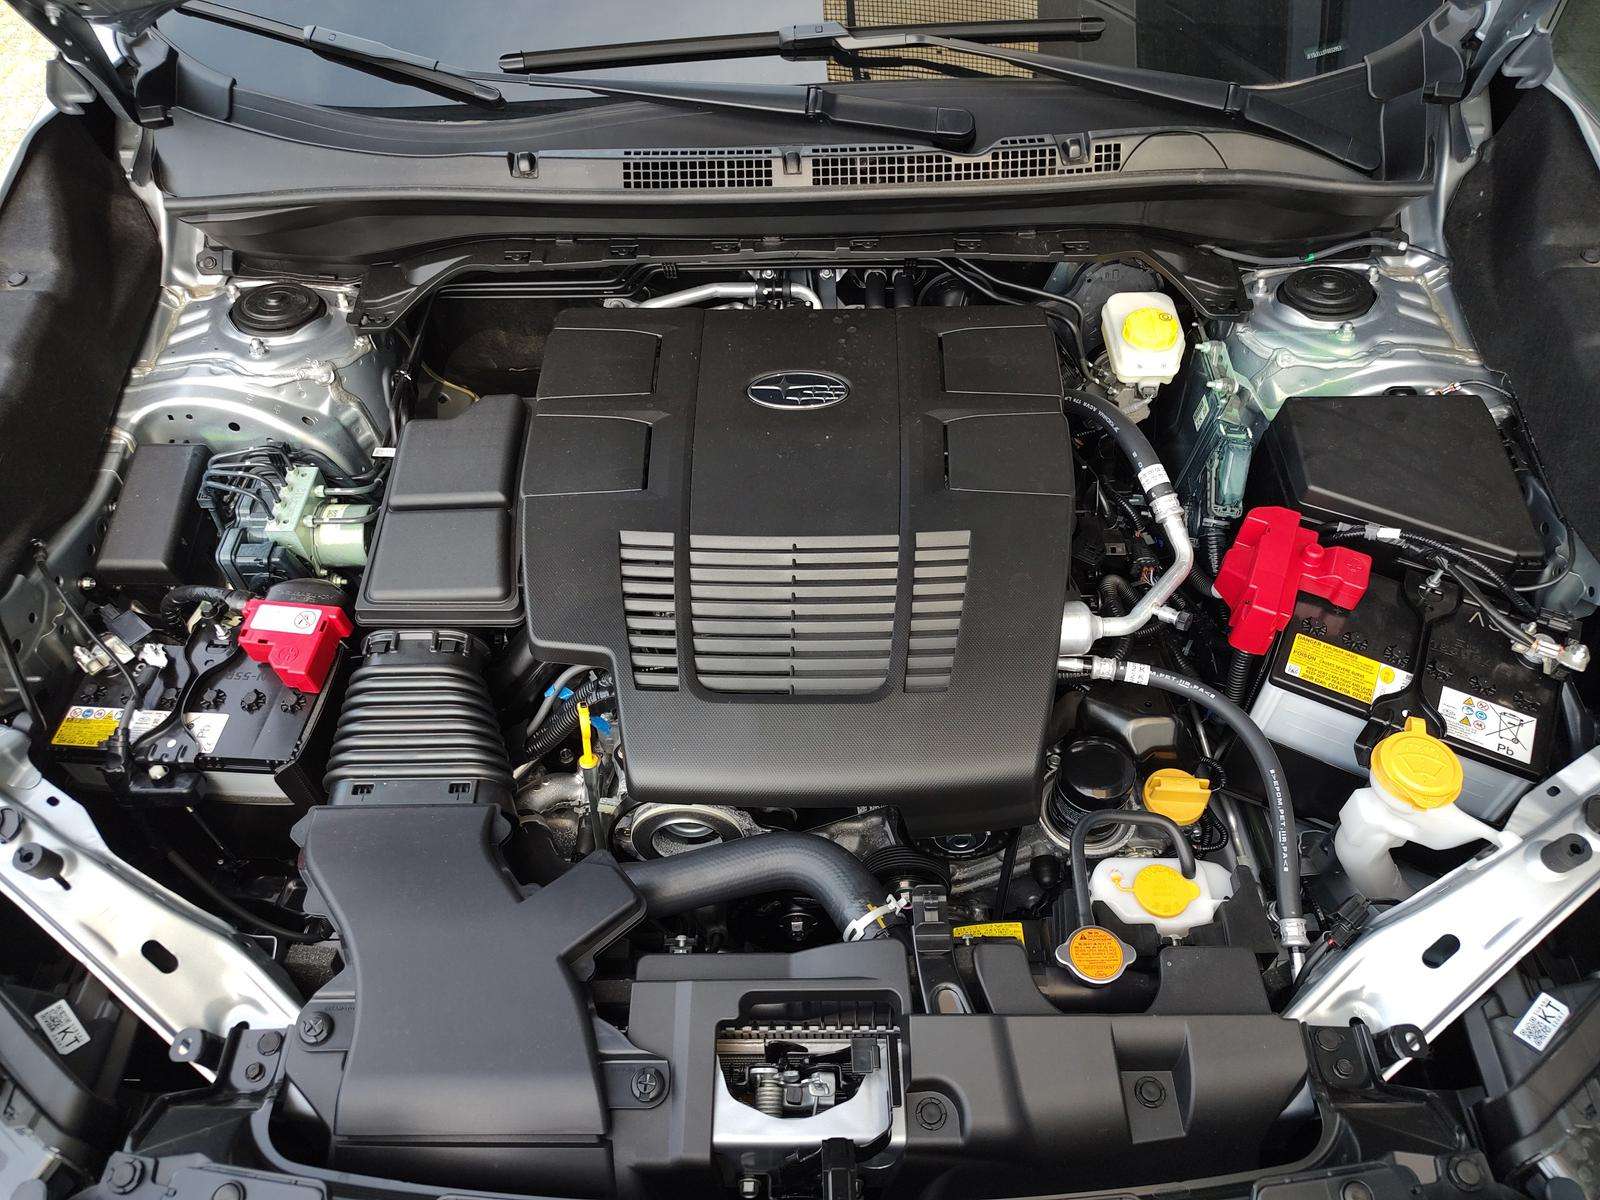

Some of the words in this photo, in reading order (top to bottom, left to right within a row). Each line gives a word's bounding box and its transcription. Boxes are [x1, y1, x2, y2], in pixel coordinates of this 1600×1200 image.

[1495, 742, 1514, 758] Pb
[1538, 1000, 1561, 1024] KT
[57, 1026, 81, 1047] KT
